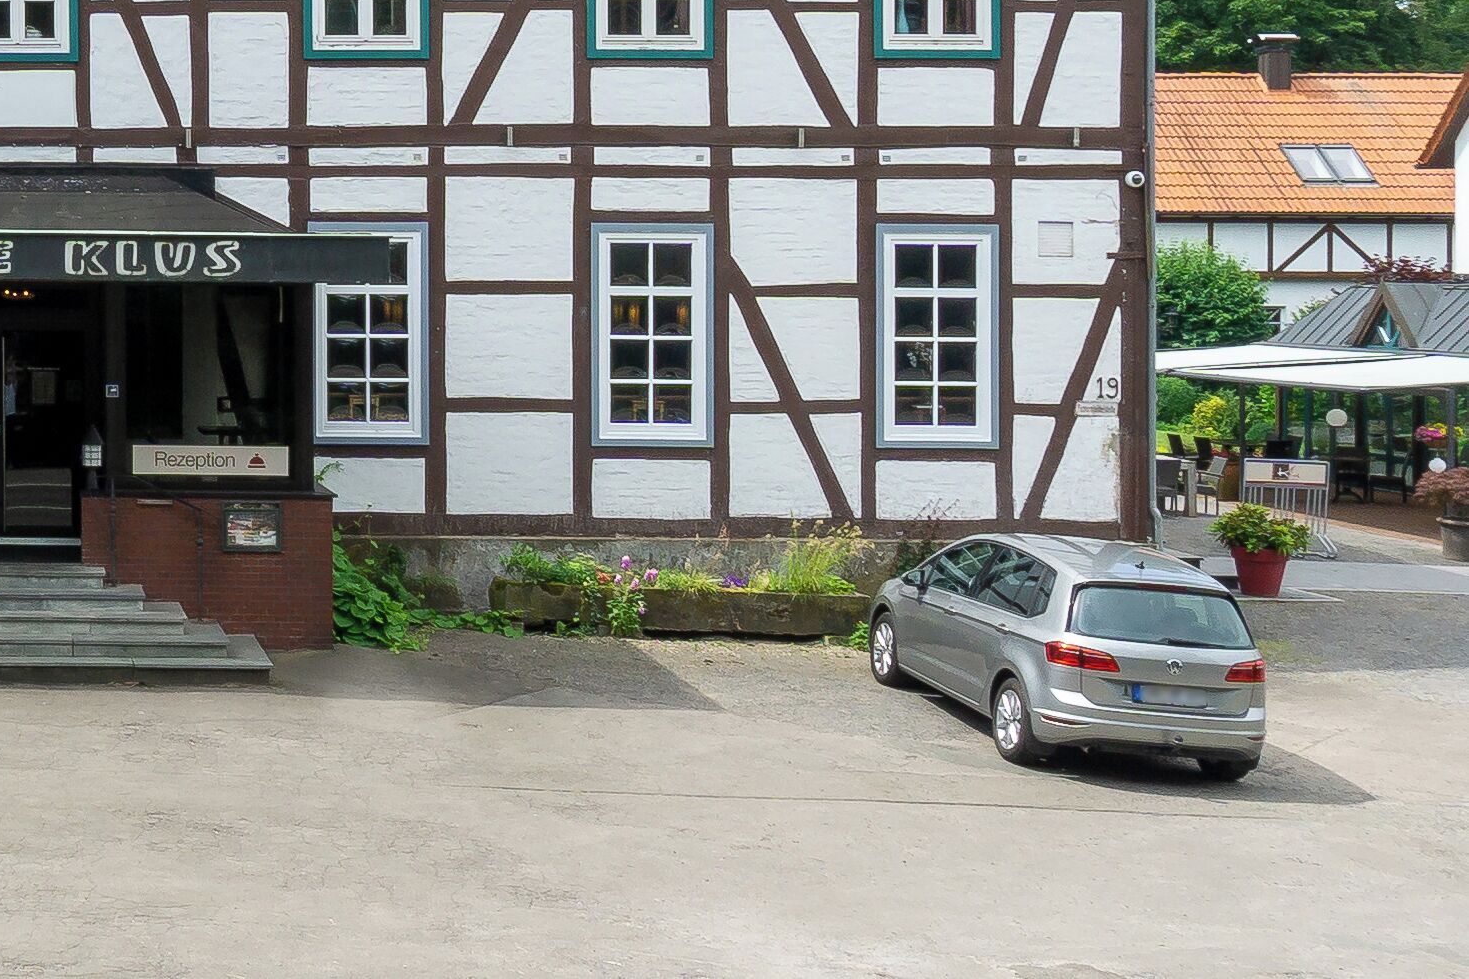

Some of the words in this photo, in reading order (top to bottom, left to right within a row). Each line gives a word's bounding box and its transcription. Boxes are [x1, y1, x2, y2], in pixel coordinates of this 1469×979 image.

[63, 240, 242, 277] KLUS
[1097, 377, 1119, 398] 19
[154, 451, 236, 470] Rezeption
